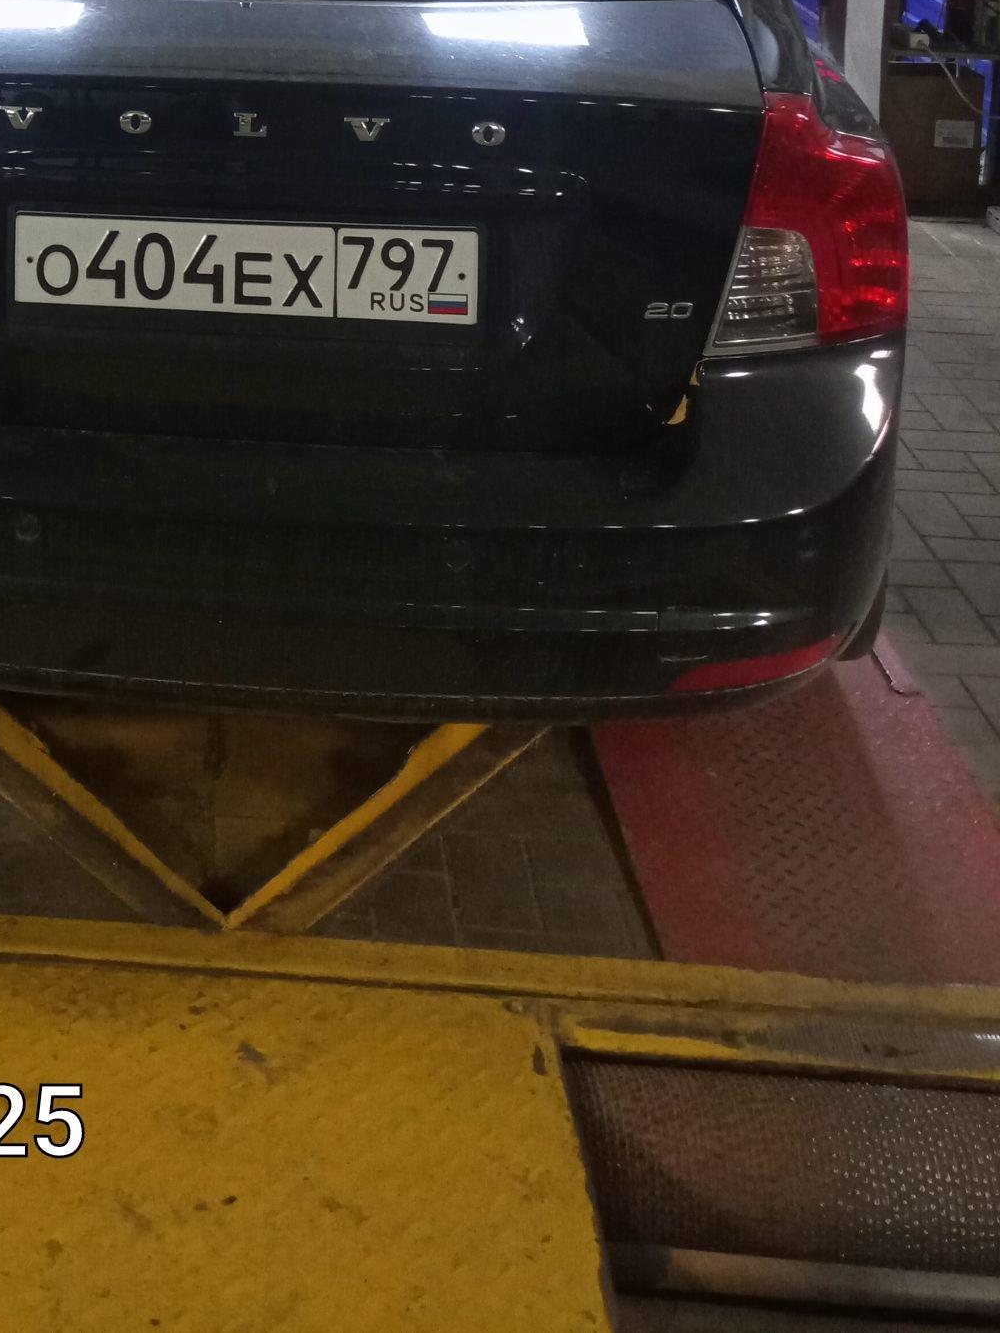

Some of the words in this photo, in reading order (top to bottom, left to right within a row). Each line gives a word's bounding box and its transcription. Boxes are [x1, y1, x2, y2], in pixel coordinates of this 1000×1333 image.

[0, 105, 506, 147] VOLVO
[36, 230, 323, 308] O404EX
[343, 236, 454, 293] 797
[370, 292, 425, 313] RUS
